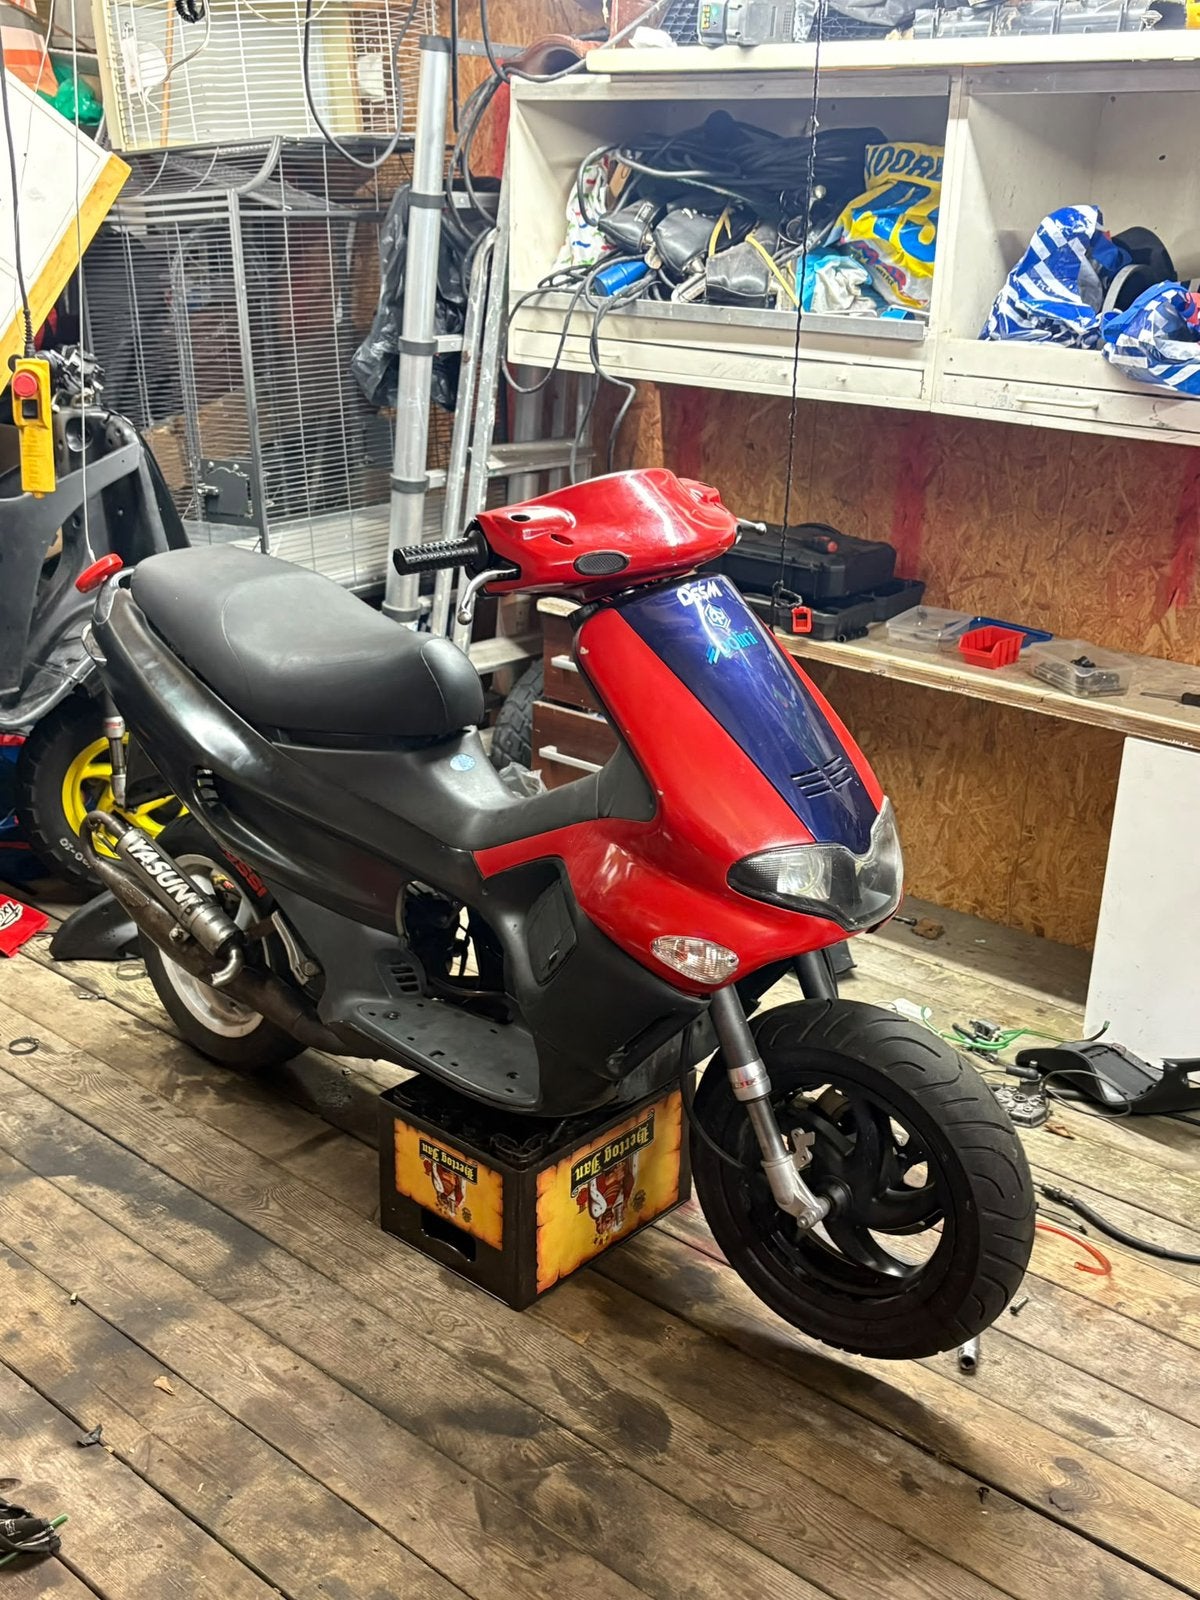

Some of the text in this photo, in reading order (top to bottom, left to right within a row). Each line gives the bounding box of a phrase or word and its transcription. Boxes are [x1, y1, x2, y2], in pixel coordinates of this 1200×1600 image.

[421, 1142, 475, 1181] Hertog Jan
[575, 1123, 650, 1181] Hertog Jan
